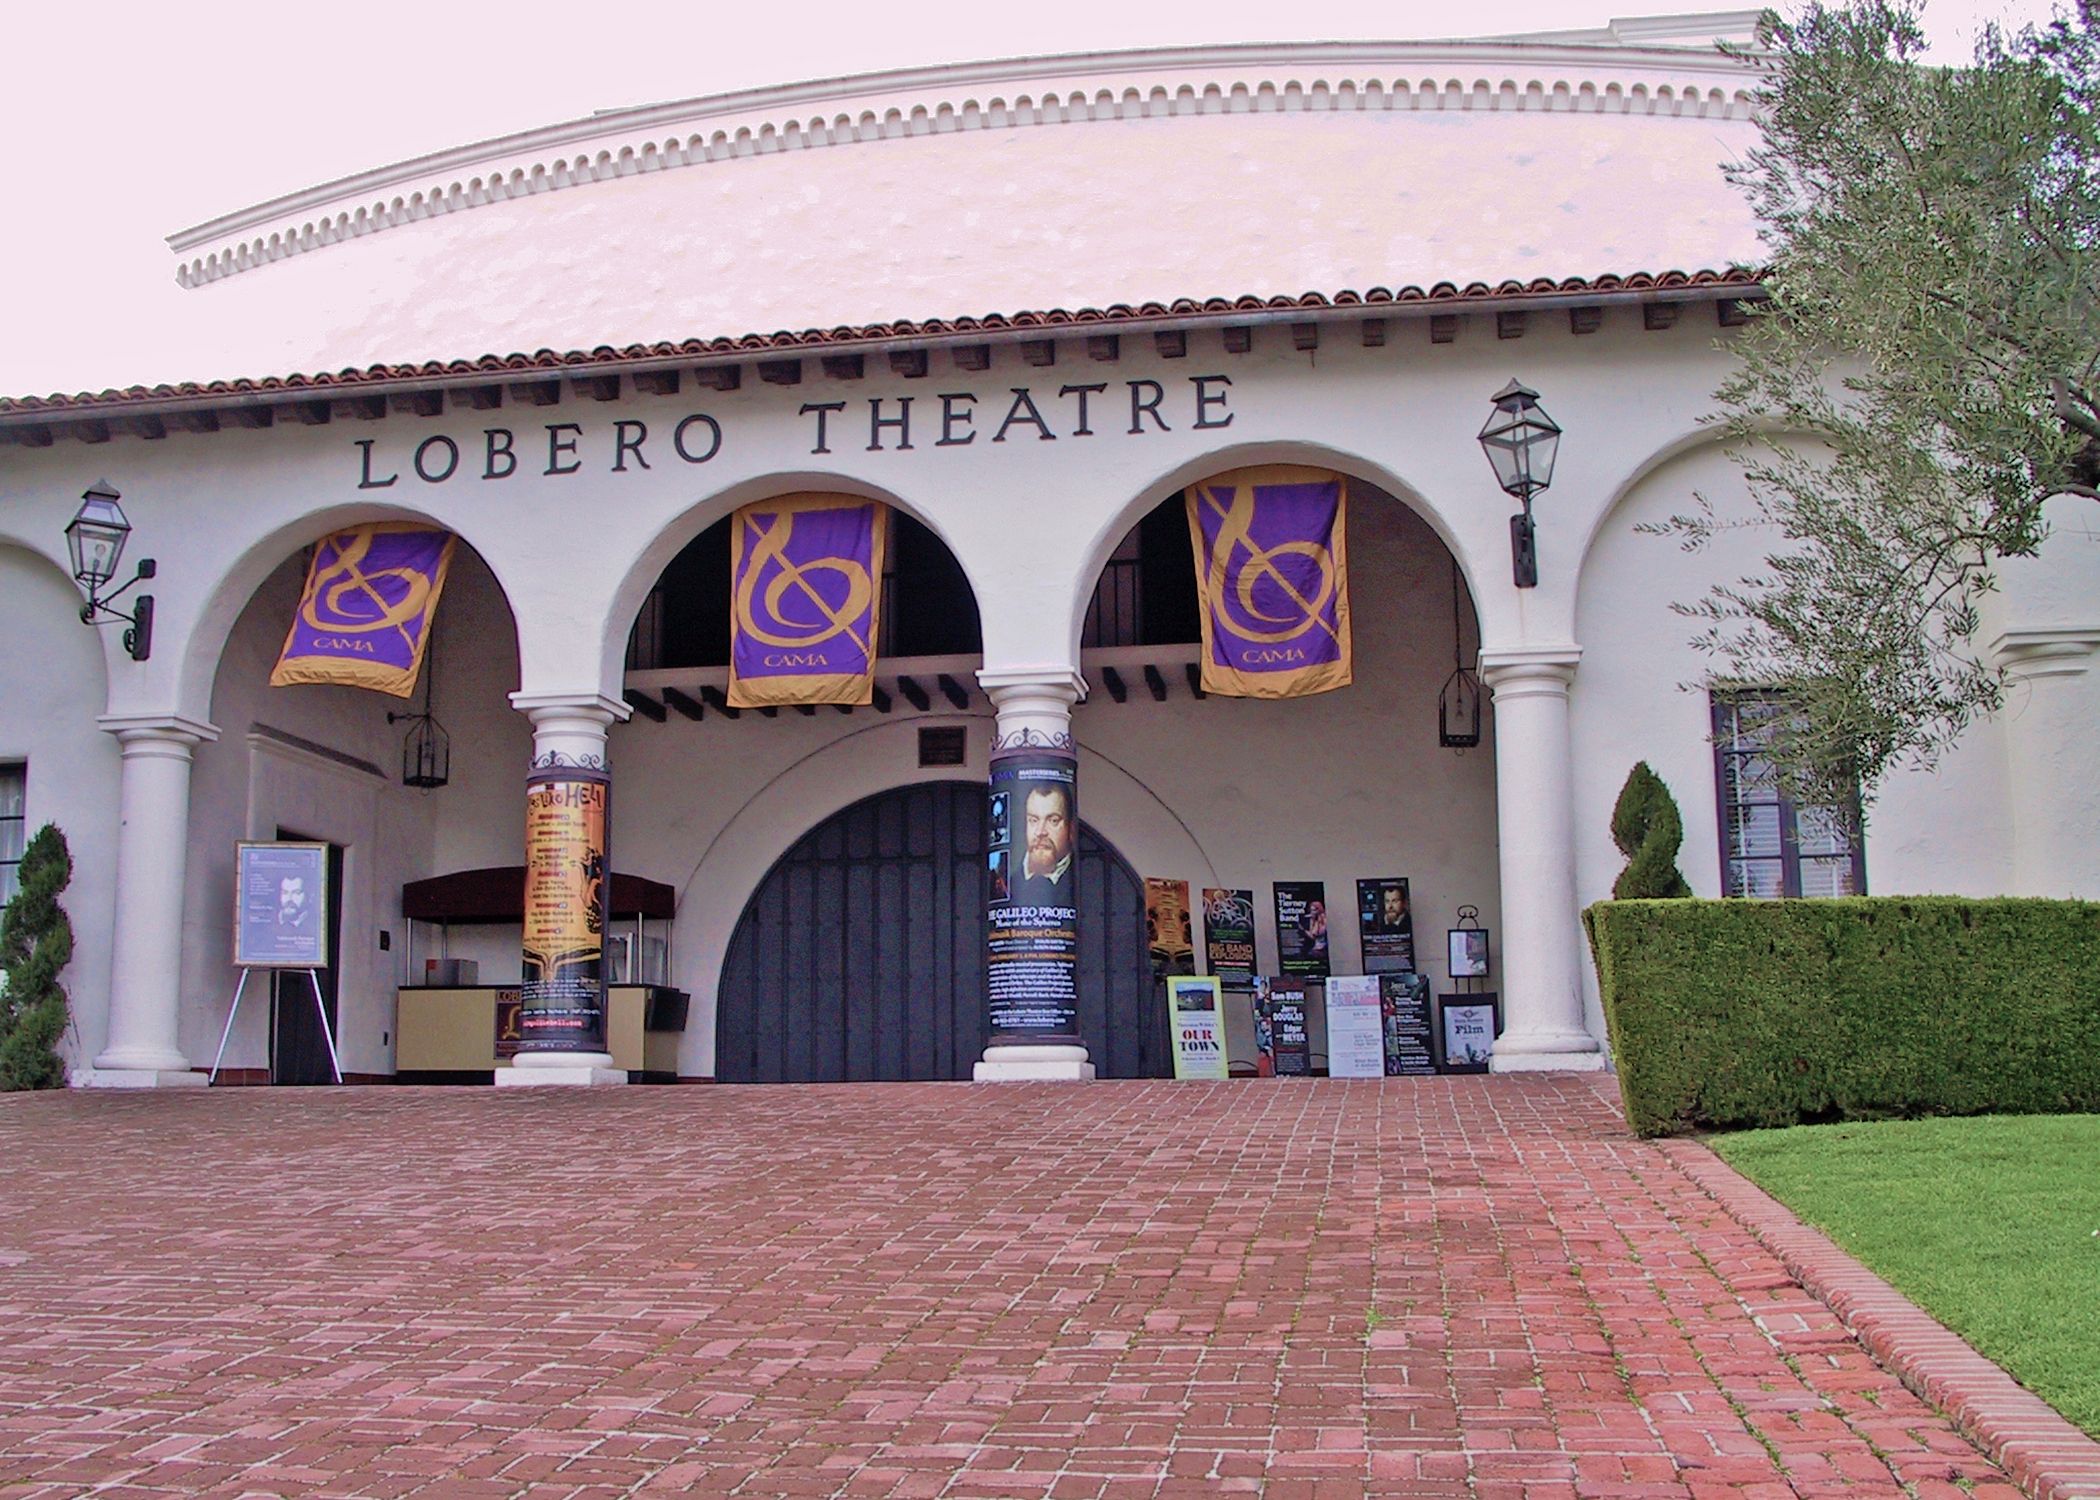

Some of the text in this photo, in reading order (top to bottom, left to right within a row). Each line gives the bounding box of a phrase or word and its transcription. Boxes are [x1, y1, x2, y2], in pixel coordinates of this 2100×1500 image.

[354, 374, 1235, 489] LOBERO THEATRE
[313, 637, 374, 653] CAMA
[763, 653, 828, 667] CAMA
[1242, 648, 1305, 663] CAMA
[996, 906, 1038, 919] GALILEO
[1279, 914, 1300, 922] Band
[1226, 943, 1253, 953] BAND
[1273, 1011, 1304, 1021] DOUGLAS
[1454, 1023, 1484, 1034] Film
[1182, 1029, 1213, 1040] OUR
[1178, 1040, 1220, 1051] TOWN
